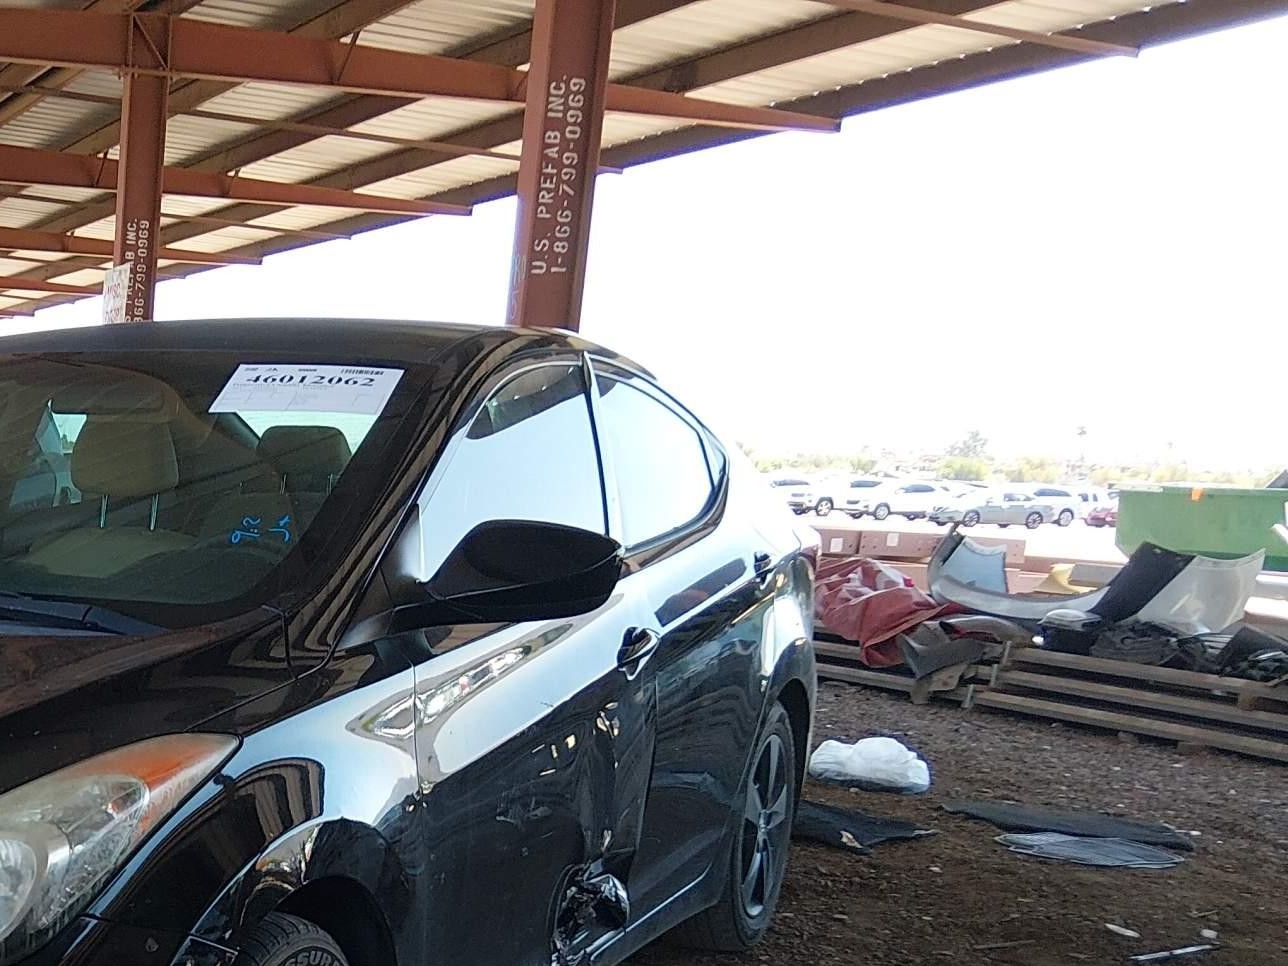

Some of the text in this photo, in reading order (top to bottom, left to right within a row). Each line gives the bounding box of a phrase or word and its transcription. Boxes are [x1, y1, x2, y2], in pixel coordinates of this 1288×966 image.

[530, 74, 568, 275] U.S. PREFAB INC.
[550, 77, 586, 273] 1-866-799-0969
[126, 218, 138, 244] INC.
[246, 374, 376, 388] 46012062
